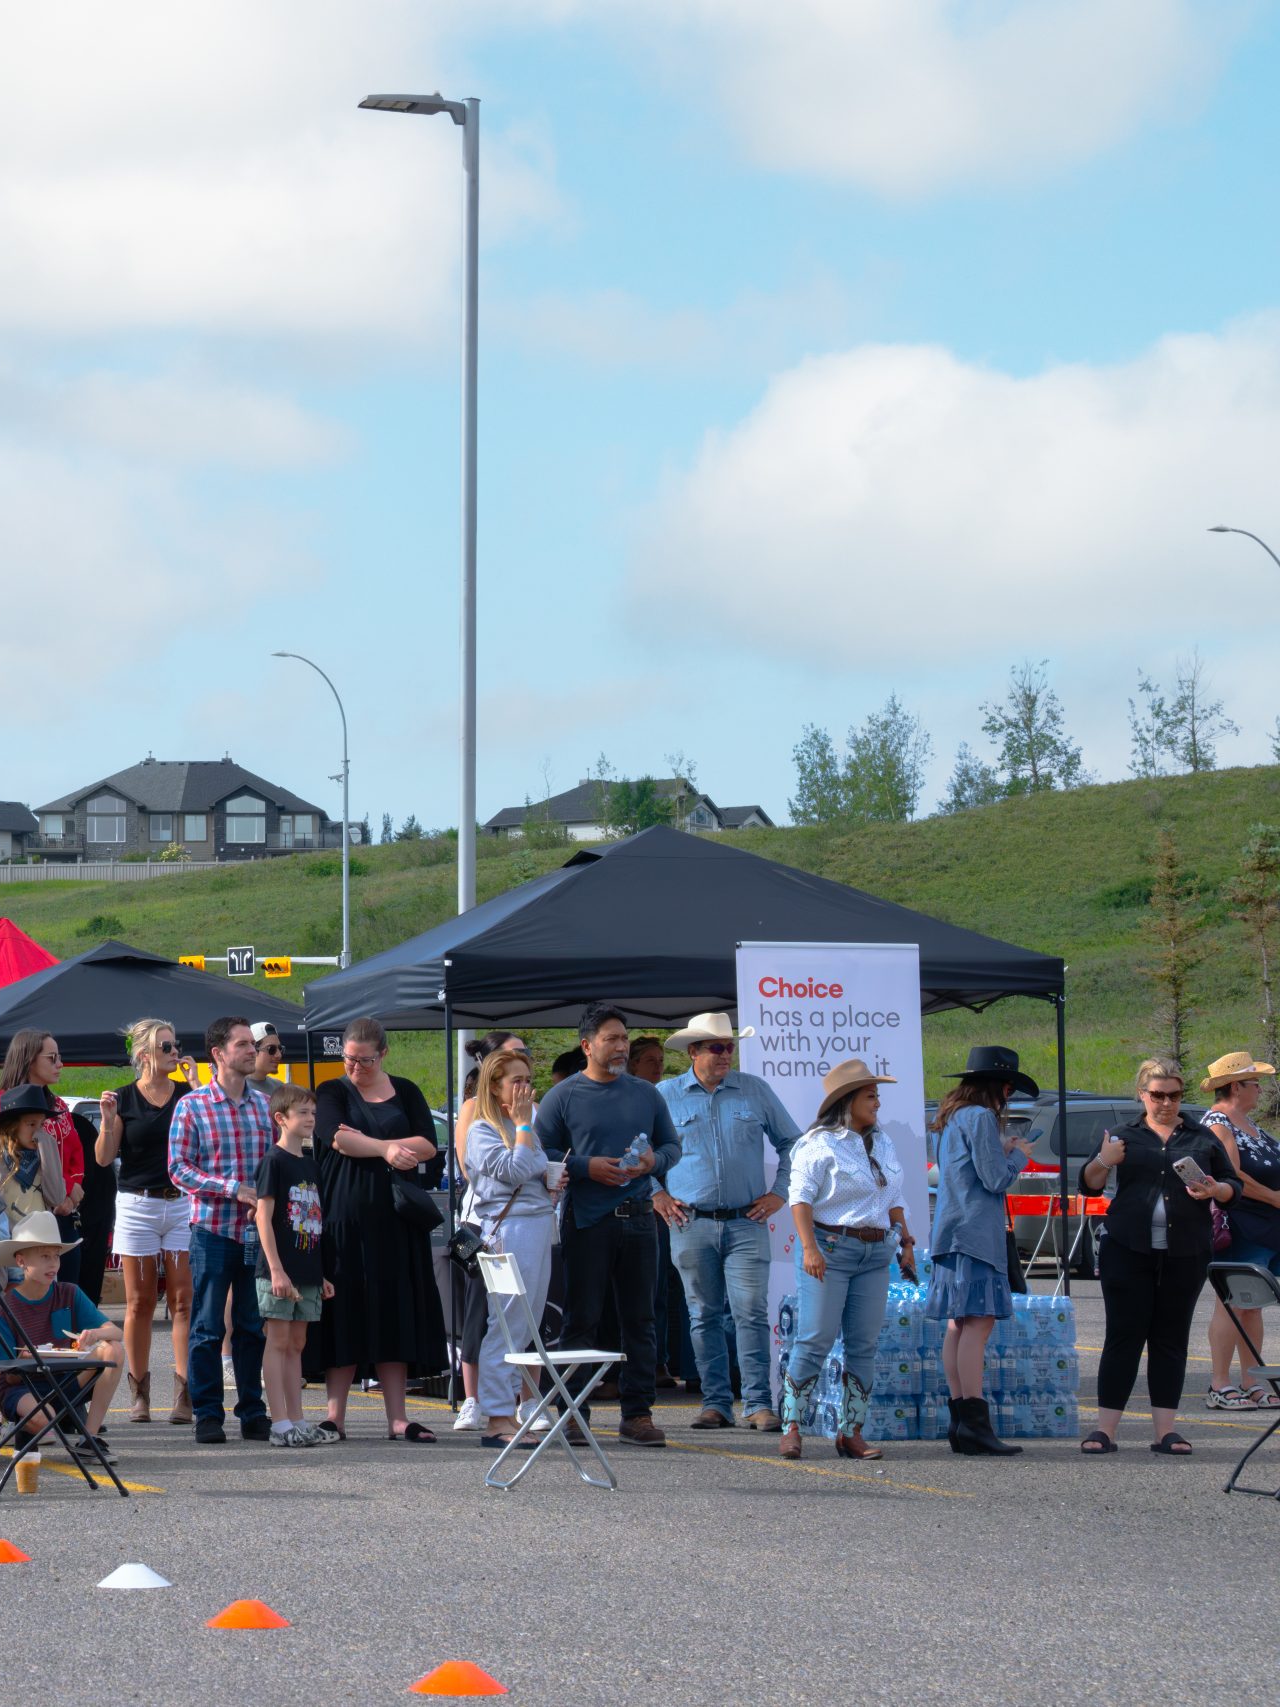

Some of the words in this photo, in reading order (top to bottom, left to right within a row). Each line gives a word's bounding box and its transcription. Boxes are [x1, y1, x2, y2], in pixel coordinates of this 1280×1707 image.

[758, 976, 844, 999] Choice
[760, 1003, 803, 1027] has
[809, 1010, 825, 1027] a
[833, 1005, 901, 1033] place
[760, 1029, 811, 1052] with
[816, 1036, 871, 1058] your
[762, 1060, 831, 1077] name
[875, 1054, 891, 1077] it
